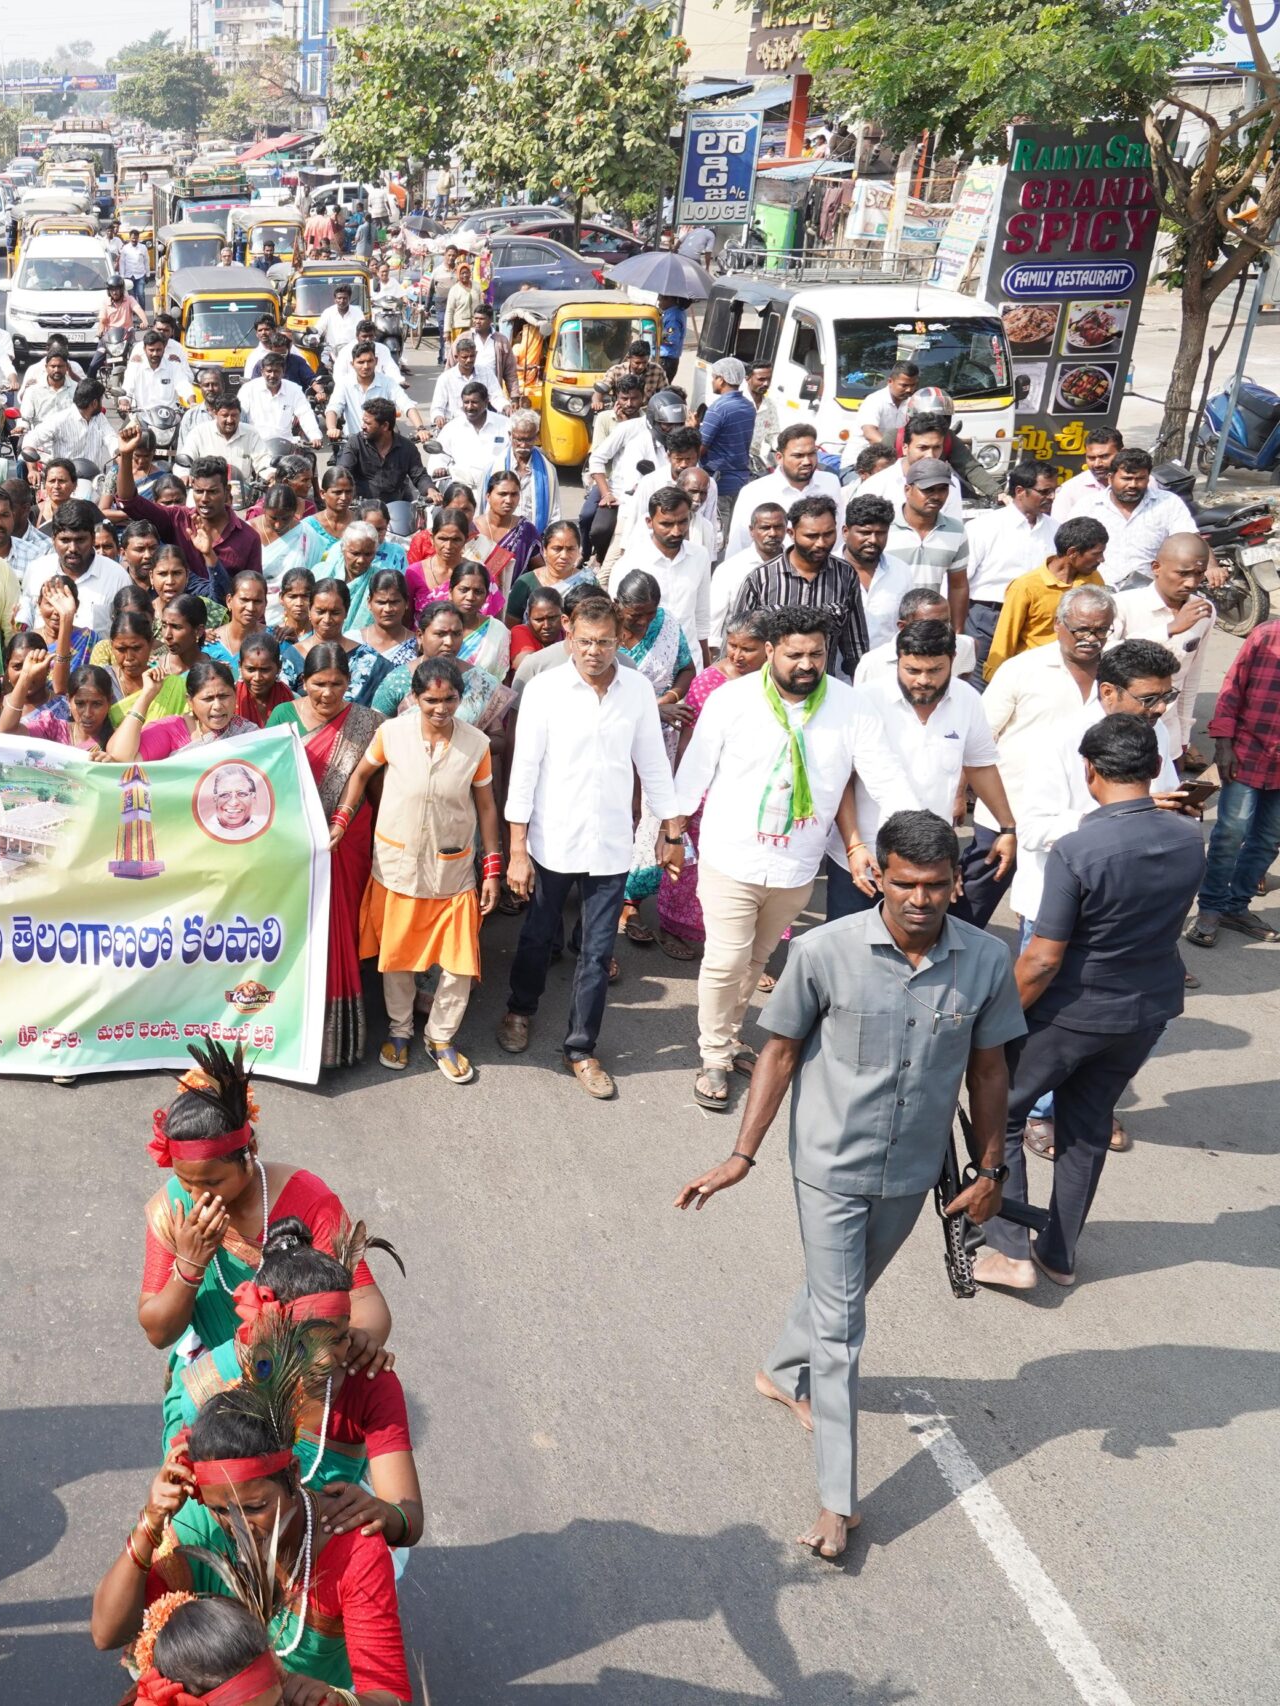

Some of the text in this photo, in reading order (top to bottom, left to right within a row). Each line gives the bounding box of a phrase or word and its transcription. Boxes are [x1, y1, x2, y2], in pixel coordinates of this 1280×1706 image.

[1011, 139, 1102, 171] RAMYA
[729, 186, 746, 200] A/C
[1019, 177, 1153, 209] GRAND
[683, 202, 747, 220] LODGE
[1003, 210, 1157, 255] SPICY
[1014, 269, 1128, 287] FAMILY RESTAURANT
[12, 916, 173, 968] తెలంగాణలో
[182, 915, 281, 964] కలపాలి
